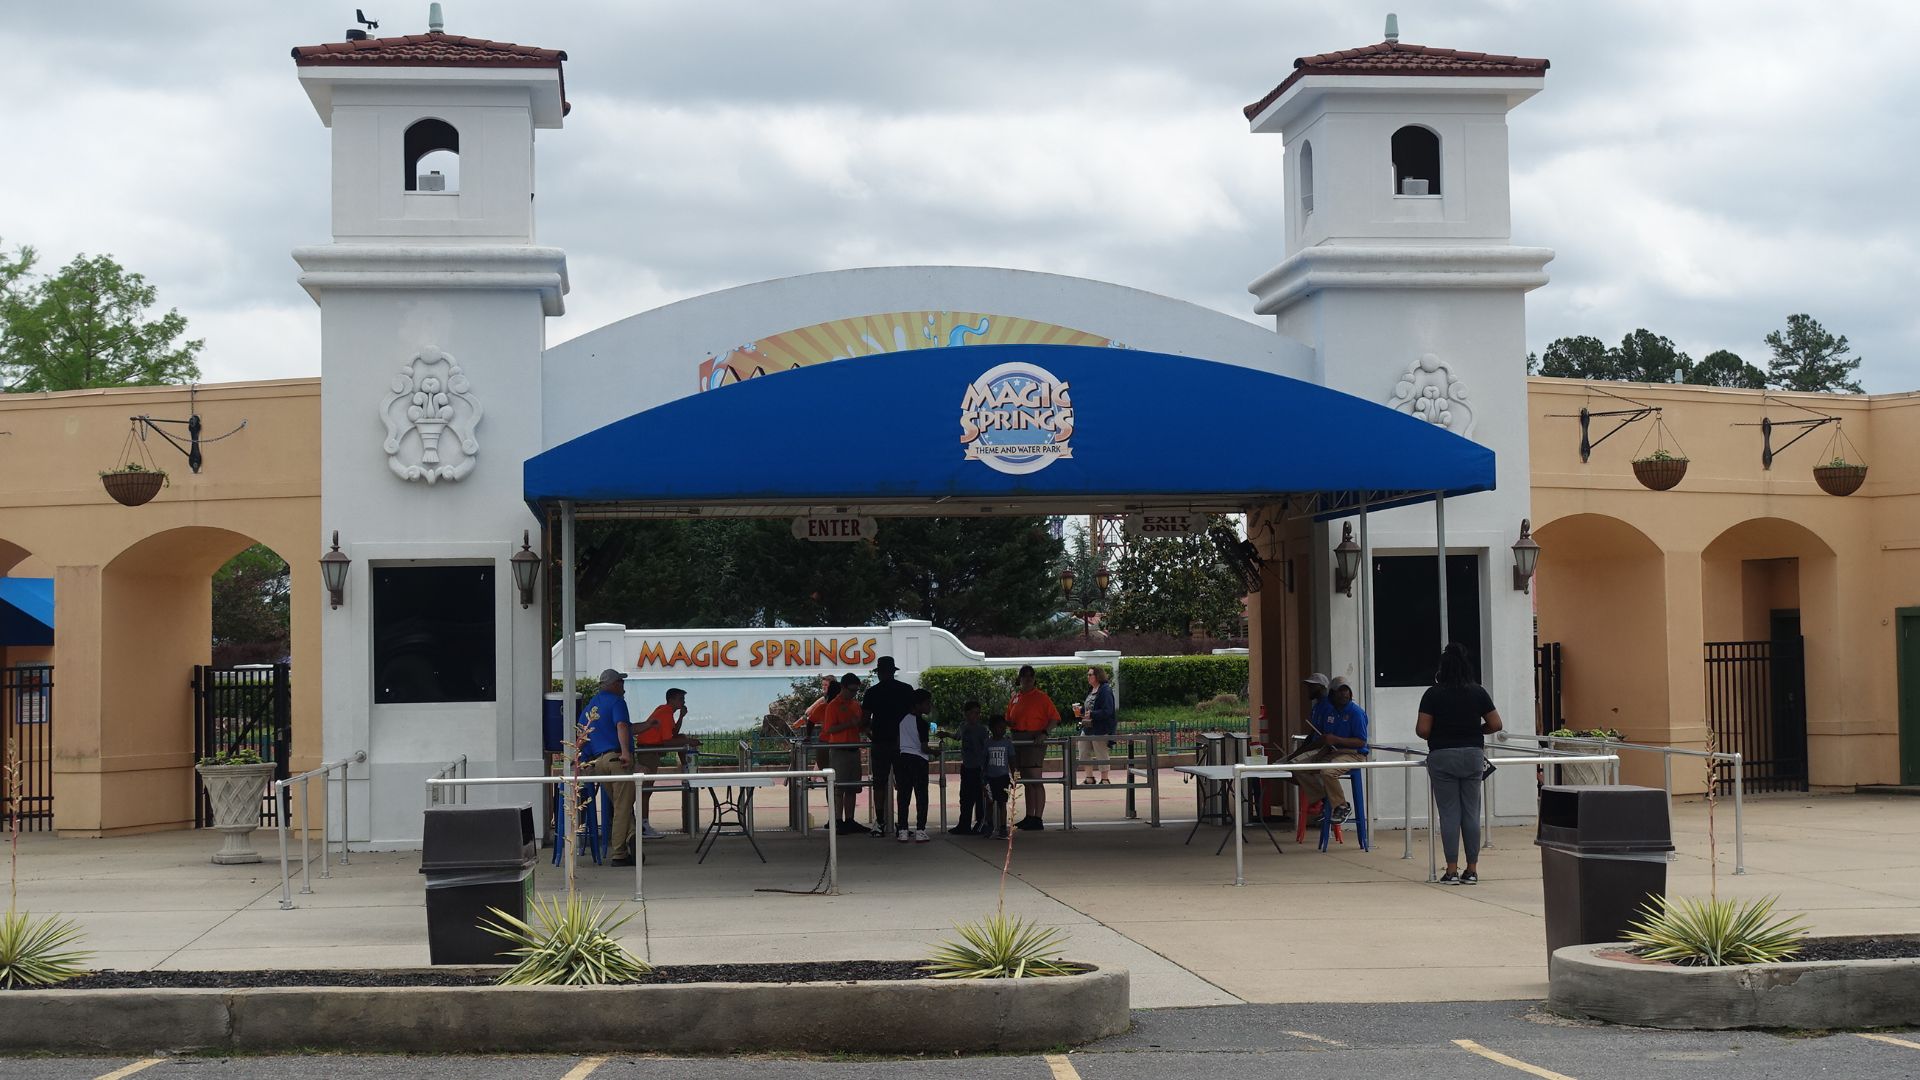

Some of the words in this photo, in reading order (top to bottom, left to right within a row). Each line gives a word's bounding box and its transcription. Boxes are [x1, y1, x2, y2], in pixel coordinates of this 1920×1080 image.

[960, 381, 1072, 411] MAGIC
[960, 408, 1073, 443] SPRINGS
[976, 446, 999, 454] THEME
[1000, 446, 1017, 454] AND
[1018, 446, 1041, 454] WATER
[1043, 445, 1061, 453] PARK
[808, 519, 861, 537] ENTER
[1142, 524, 1192, 532] ONLY
[1143, 516, 1190, 524] EXIT
[637, 640, 739, 668] MAGIC
[750, 637, 877, 666] SPRINGS
